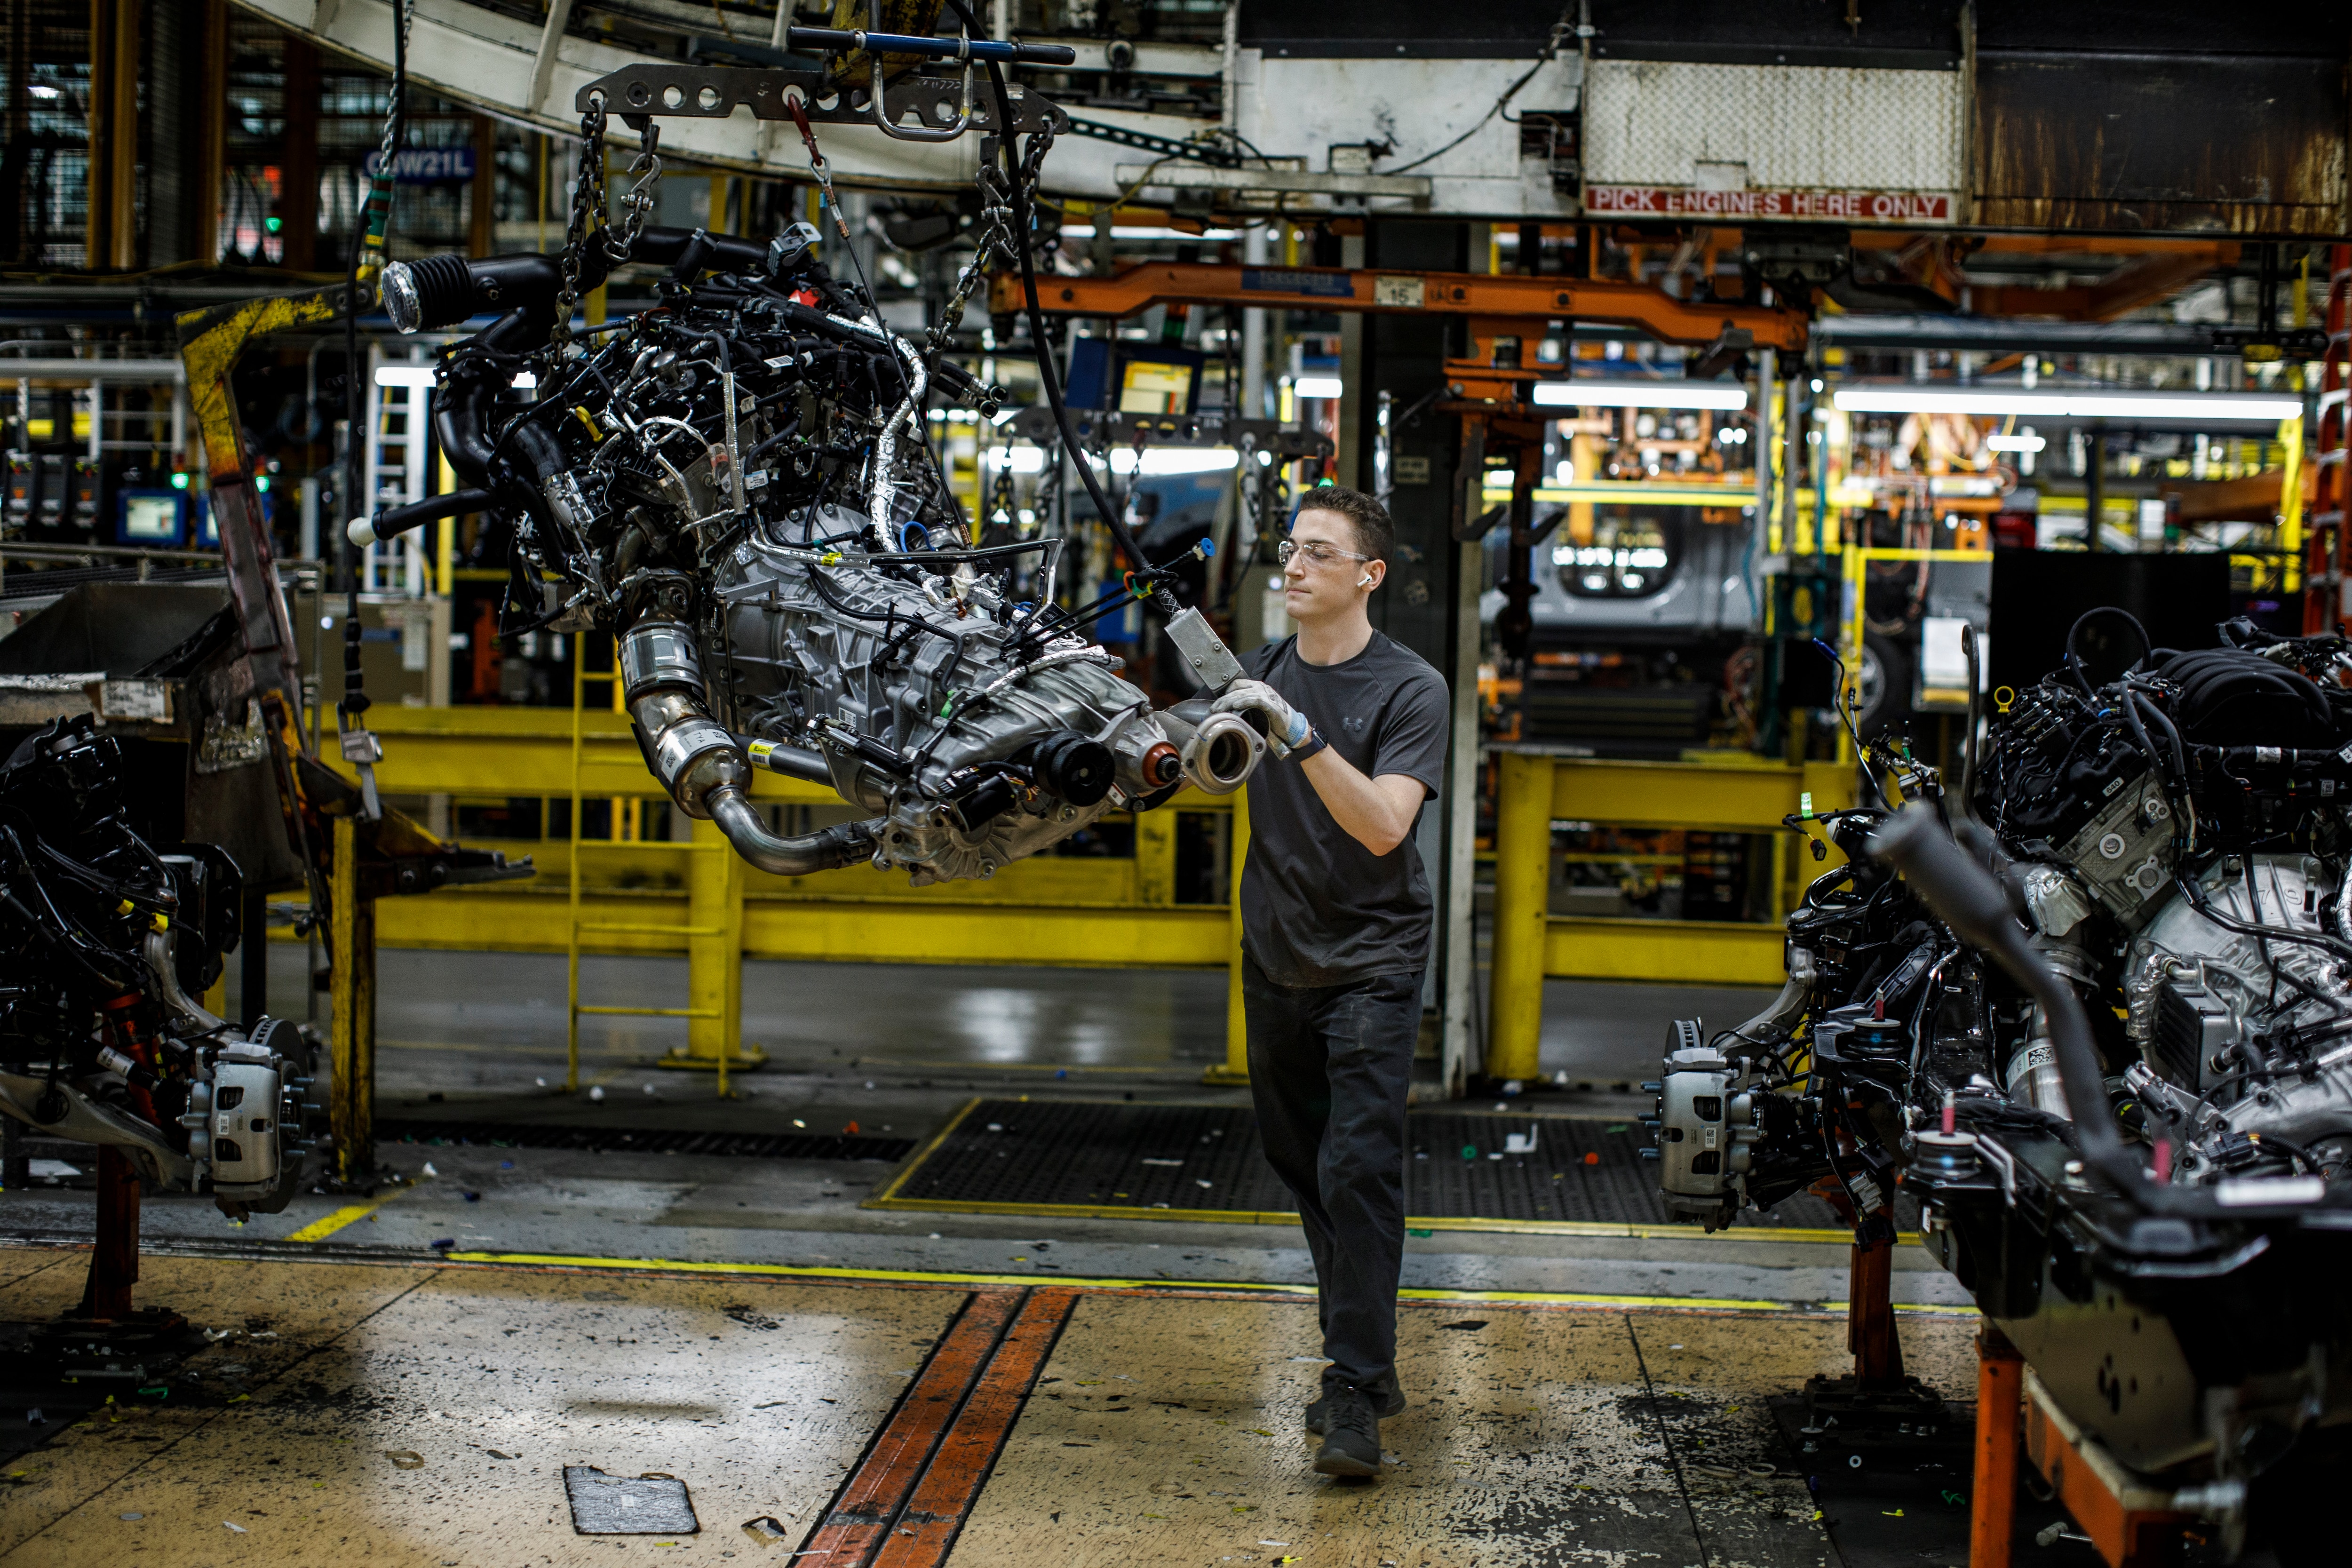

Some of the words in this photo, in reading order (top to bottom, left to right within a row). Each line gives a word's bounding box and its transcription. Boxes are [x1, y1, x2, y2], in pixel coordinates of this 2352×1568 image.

[1594, 189, 1656, 210] PICK
[1666, 191, 1782, 213] ENGINES
[1792, 193, 1862, 215] HERE
[1872, 195, 1939, 217] ONLY
[1391, 287, 1409, 303] 15
[693, 732, 706, 743] TYA
[2106, 780, 2120, 793] 640
